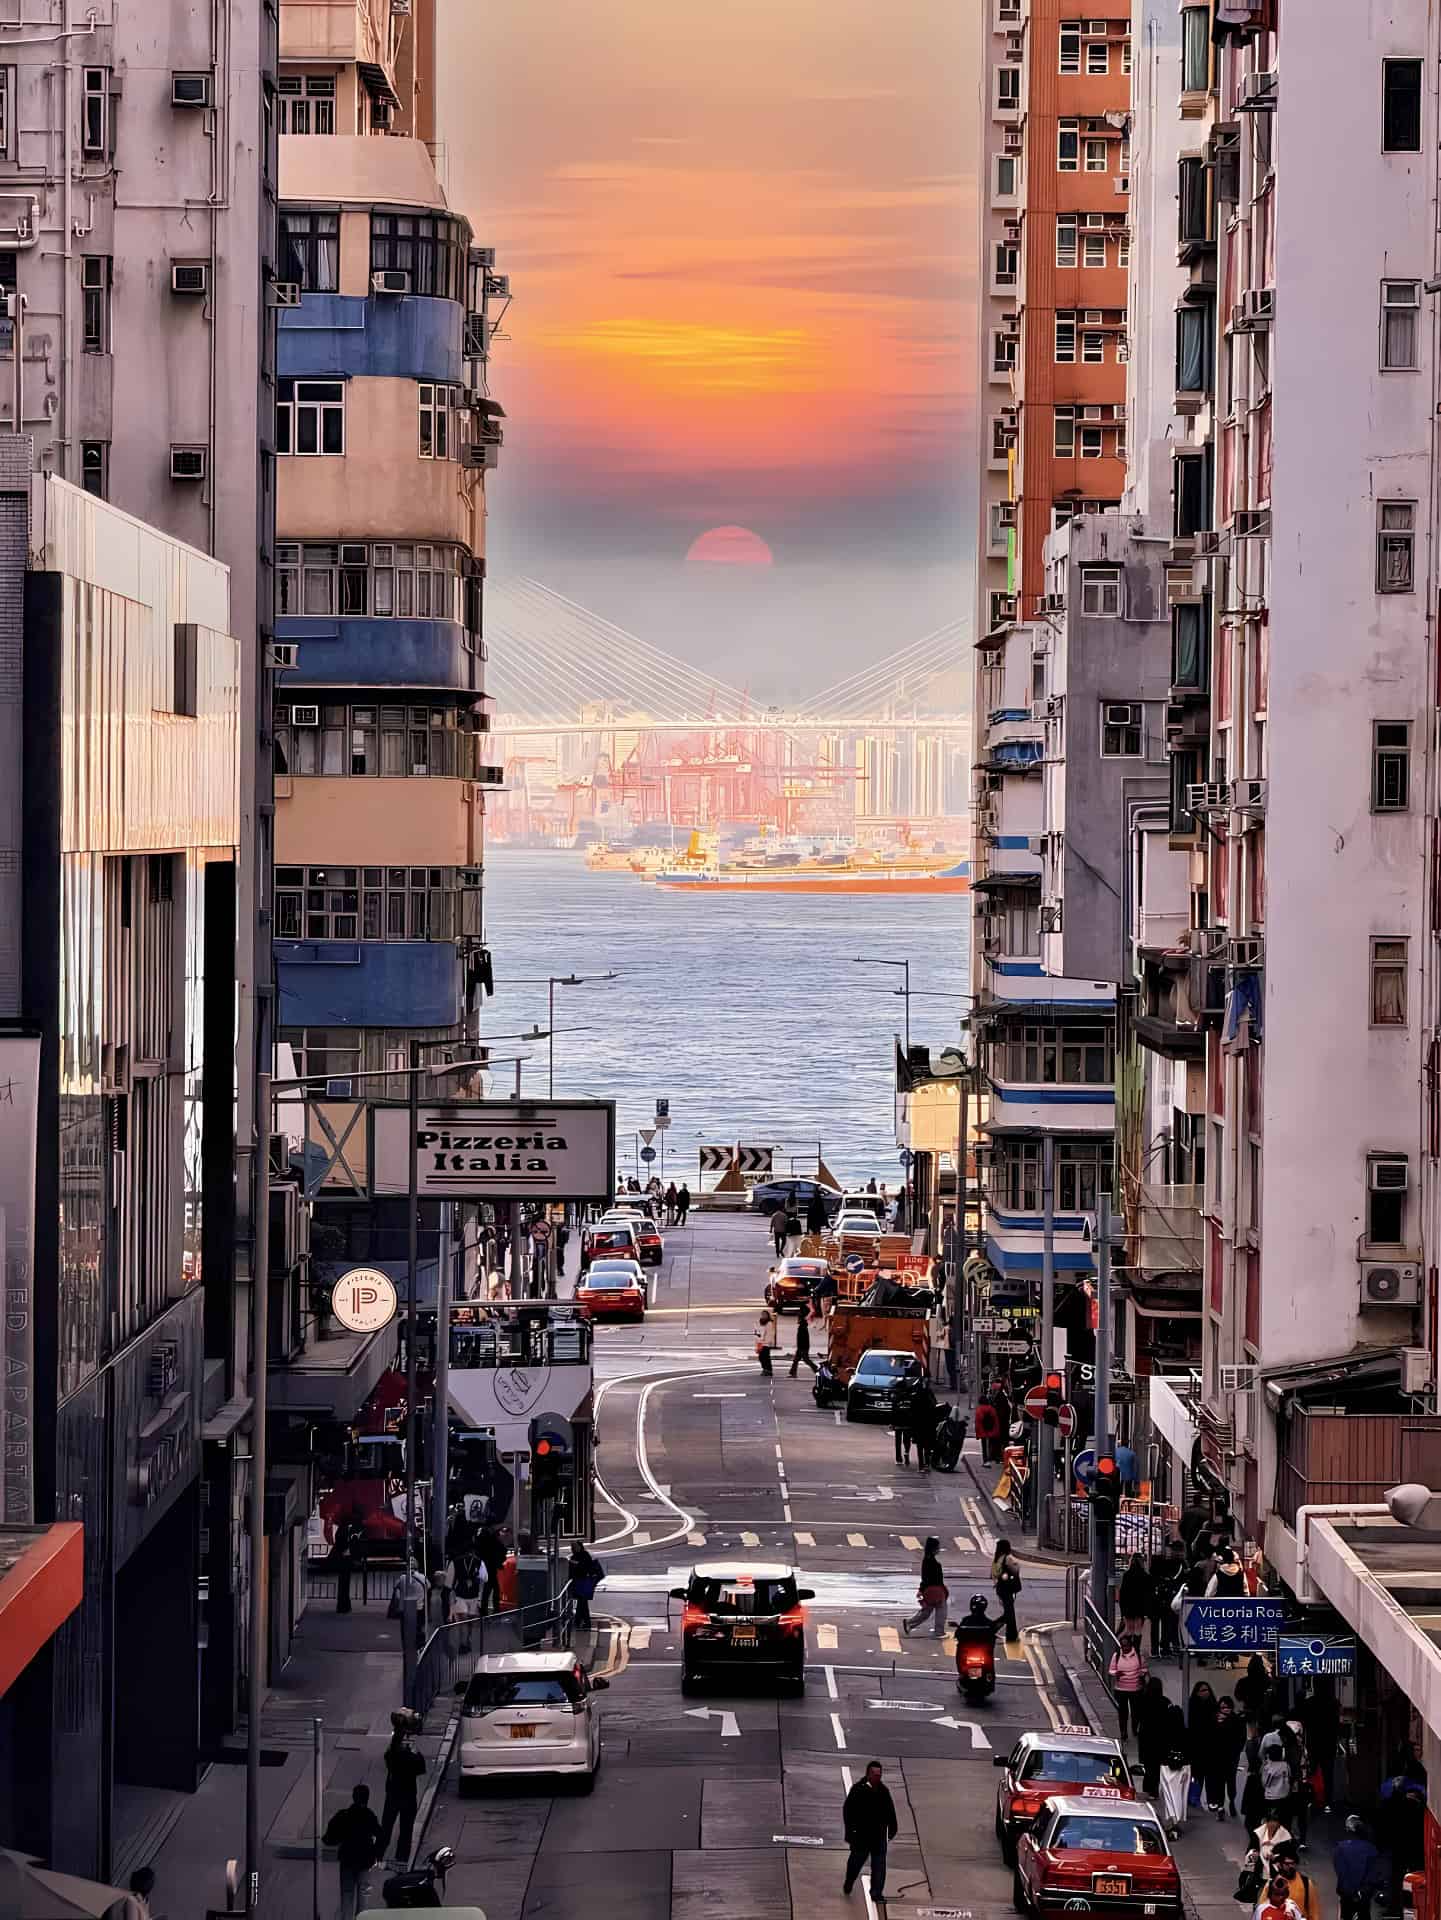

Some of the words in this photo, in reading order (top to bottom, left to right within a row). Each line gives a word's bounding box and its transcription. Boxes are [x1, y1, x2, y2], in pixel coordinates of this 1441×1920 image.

[416, 1131, 568, 1150] Pizzeria
[433, 1153, 549, 1171] Italia
[1198, 1605, 1254, 1618] Victoria
[1256, 1606, 1283, 1618] Roa
[1199, 1624, 1280, 1643] 域多利道
[1282, 1657, 1313, 1674] 洗衣
